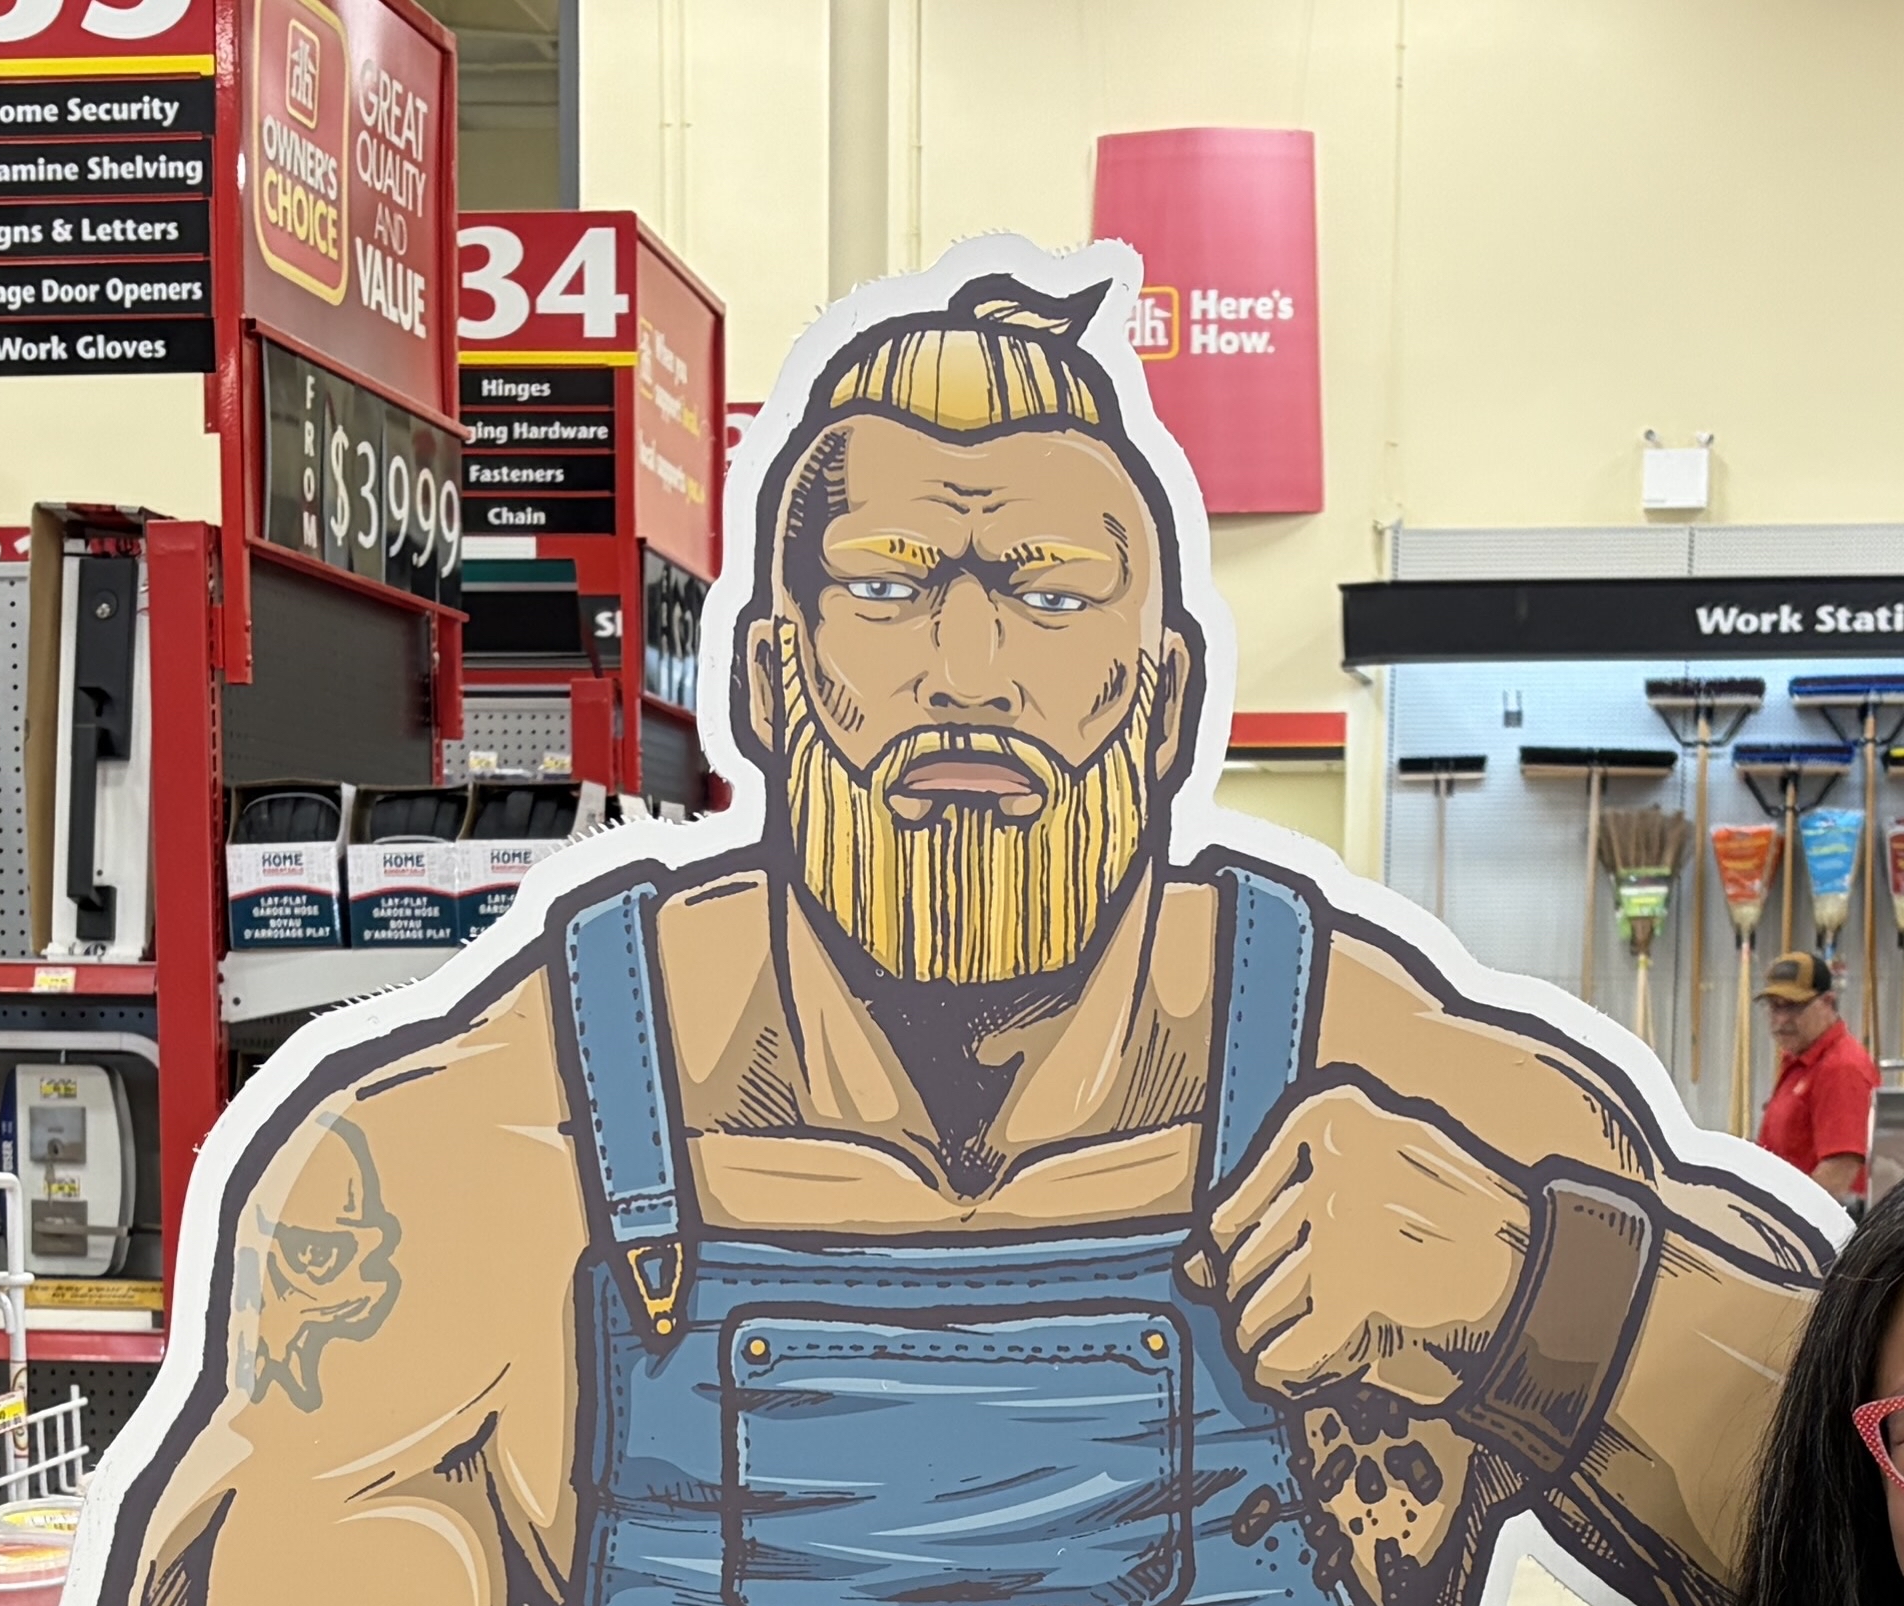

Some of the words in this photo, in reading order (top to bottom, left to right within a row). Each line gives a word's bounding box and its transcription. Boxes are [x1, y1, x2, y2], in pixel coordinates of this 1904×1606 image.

[67, 95, 180, 127] Security
[357, 59, 429, 144] GREAT
[86, 154, 204, 187] Shelving
[261, 114, 339, 200] OWNER'S
[356, 127, 427, 218] QUALITY
[51, 219, 73, 243] &
[80, 215, 179, 243] Letters
[263, 167, 339, 262] CHOICE
[374, 206, 408, 256] AND
[41, 278, 99, 305] Door
[104, 277, 204, 306] Openers
[356, 238, 428, 340] VALUE
[457, 226, 630, 340] 34
[1190, 290, 1294, 320] Here's
[75, 333, 168, 361] Gloves
[1190, 325, 1276, 354] How.
[482, 379, 552, 398] Hinges
[465, 424, 509, 446] ging
[512, 421, 609, 440] Hardware
[469, 465, 565, 484] Fasteners
[487, 507, 546, 525] Chain
[1697, 604, 1803, 634] Work
